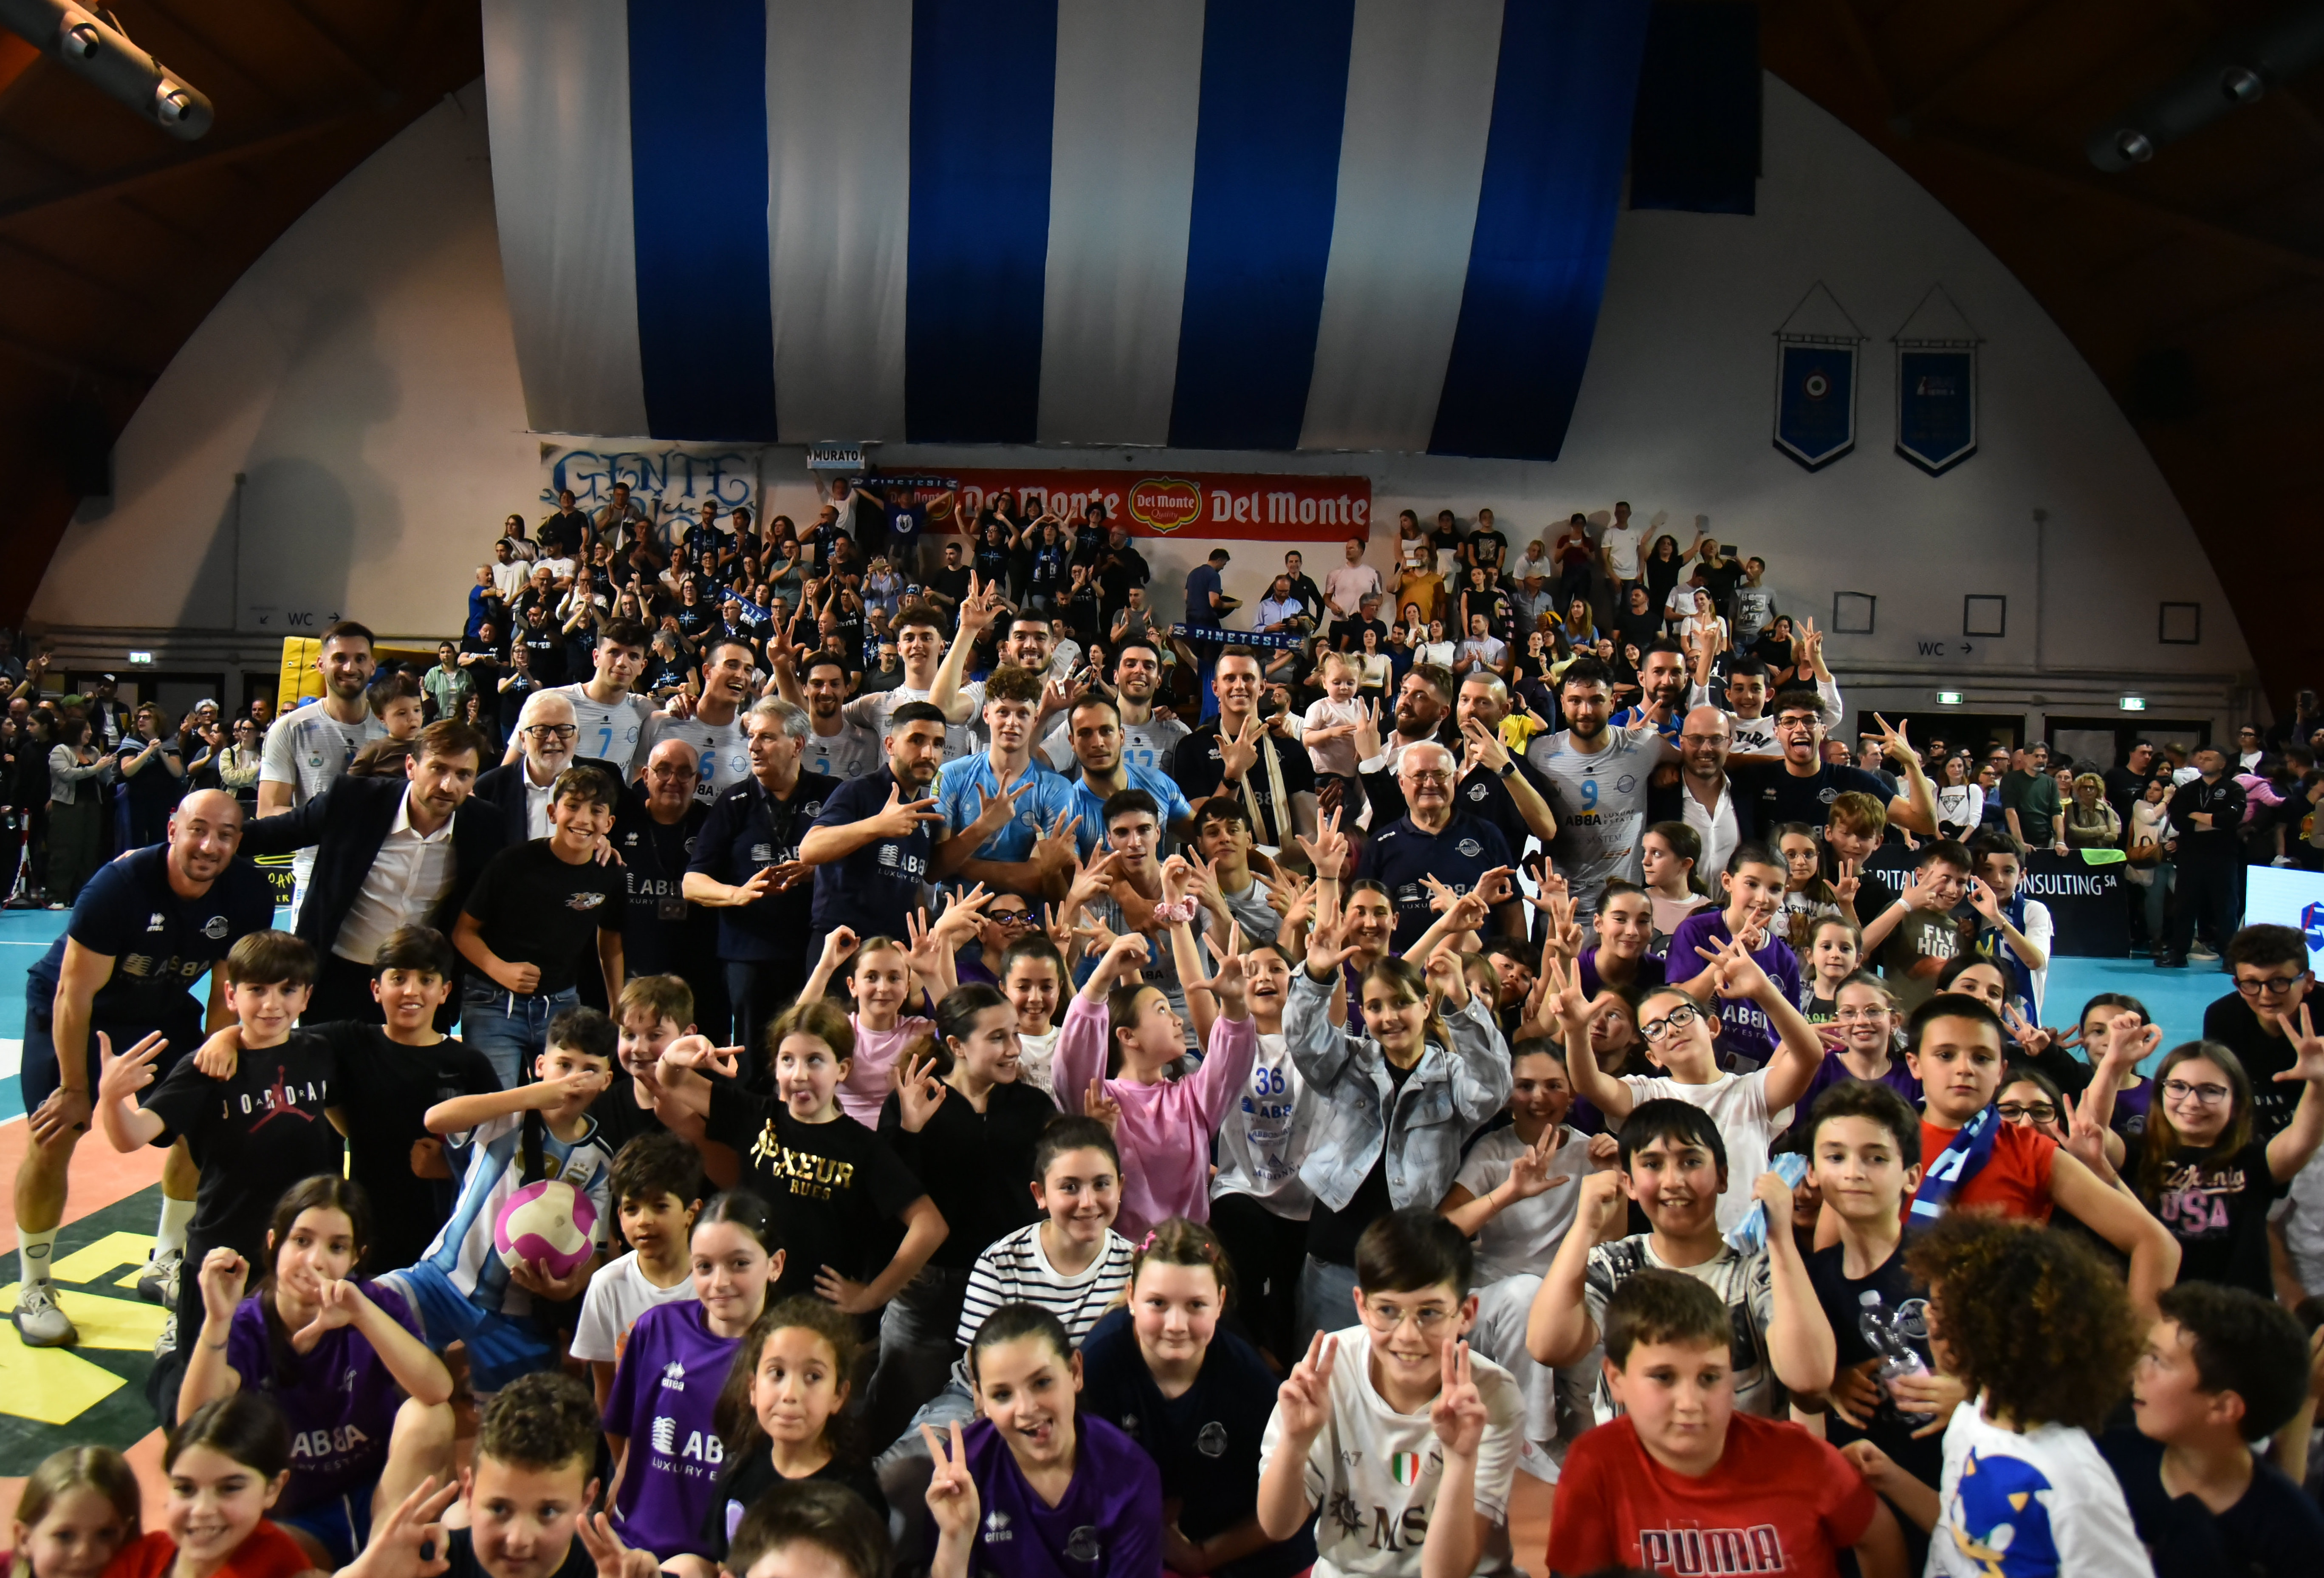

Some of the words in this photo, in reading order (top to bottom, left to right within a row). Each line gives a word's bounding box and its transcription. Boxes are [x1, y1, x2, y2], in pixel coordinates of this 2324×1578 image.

[813, 450, 858, 461] MURATO
[553, 450, 749, 506] GENTE
[1137, 495, 1155, 508] Del
[1156, 495, 1194, 509] Monte
[1211, 490, 1261, 524] Del
[1266, 491, 1369, 526] Monte
[1151, 509, 1178, 519] Quality
[288, 613, 313, 626] WC
[1195, 629, 1280, 646] PINETESI
[1918, 642, 1944, 656] WC
[599, 728, 613, 758] 7
[699, 751, 716, 781] 6
[1581, 780, 1598, 811] 9
[1565, 814, 1601, 826] ABBA
[1604, 809, 1635, 818] LUXURY
[1604, 815, 1634, 825] ESTATE
[2104, 874, 2117, 887] SA
[1924, 924, 1957, 946] FLY
[1255, 1067, 1285, 1096] 36
[790, 1178, 832, 1201] RUES
[2160, 1188, 2230, 1233] USA
[289, 1423, 369, 1458] ABBA
[652, 1456, 703, 1478] LUXURY
[1640, 1524, 1785, 1578] PUMA
